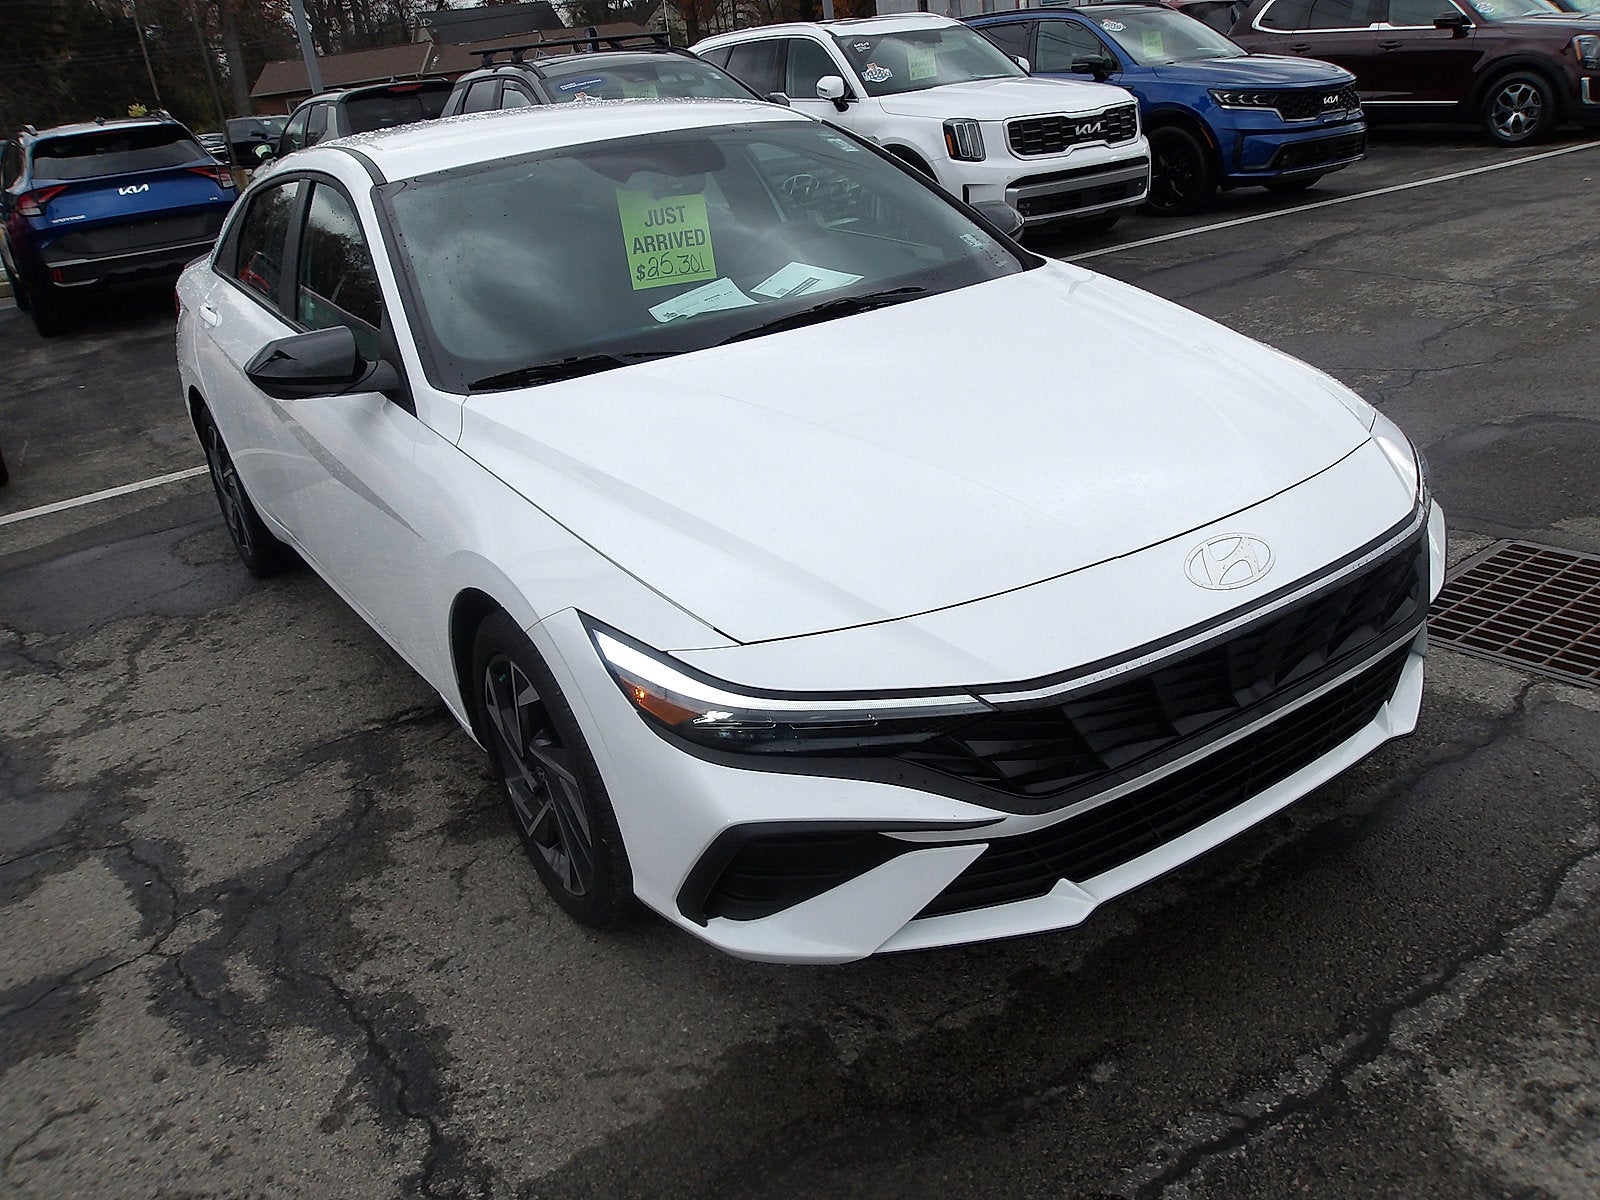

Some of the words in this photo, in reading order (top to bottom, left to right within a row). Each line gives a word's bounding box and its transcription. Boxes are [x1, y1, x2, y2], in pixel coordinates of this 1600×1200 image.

[1075, 122, 1101, 135] KIA
[118, 184, 149, 196] KIA
[644, 205, 686, 228] JUST
[633, 229, 706, 255] ARRIVED
